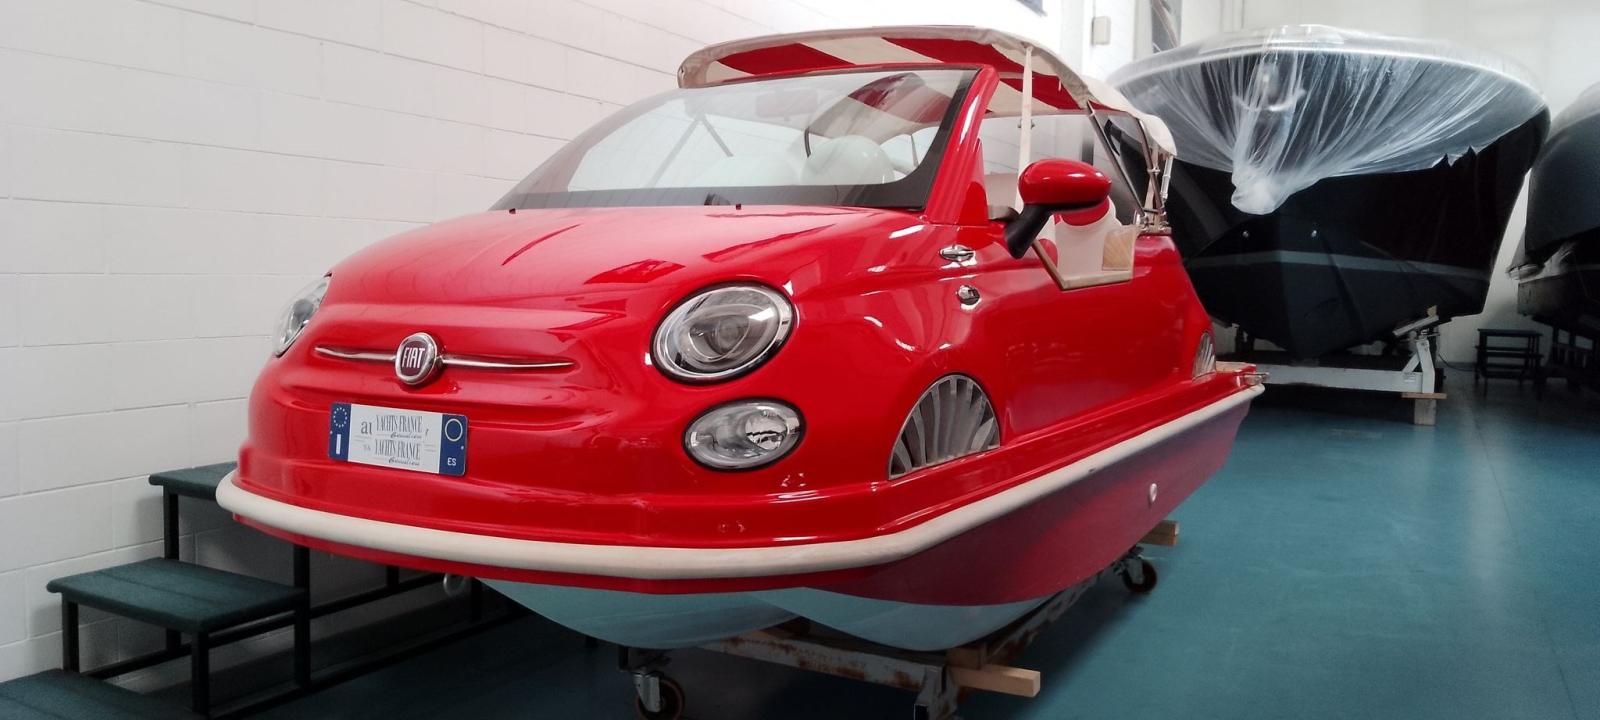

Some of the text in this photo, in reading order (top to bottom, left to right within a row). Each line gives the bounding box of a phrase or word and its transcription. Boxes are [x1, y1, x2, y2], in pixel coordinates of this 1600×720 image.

[402, 347, 425, 369] FIAT
[375, 414, 423, 433] YACHTS FRANCE
[375, 439, 421, 460] YACHTS FRANCE
[447, 457, 457, 466] ES
